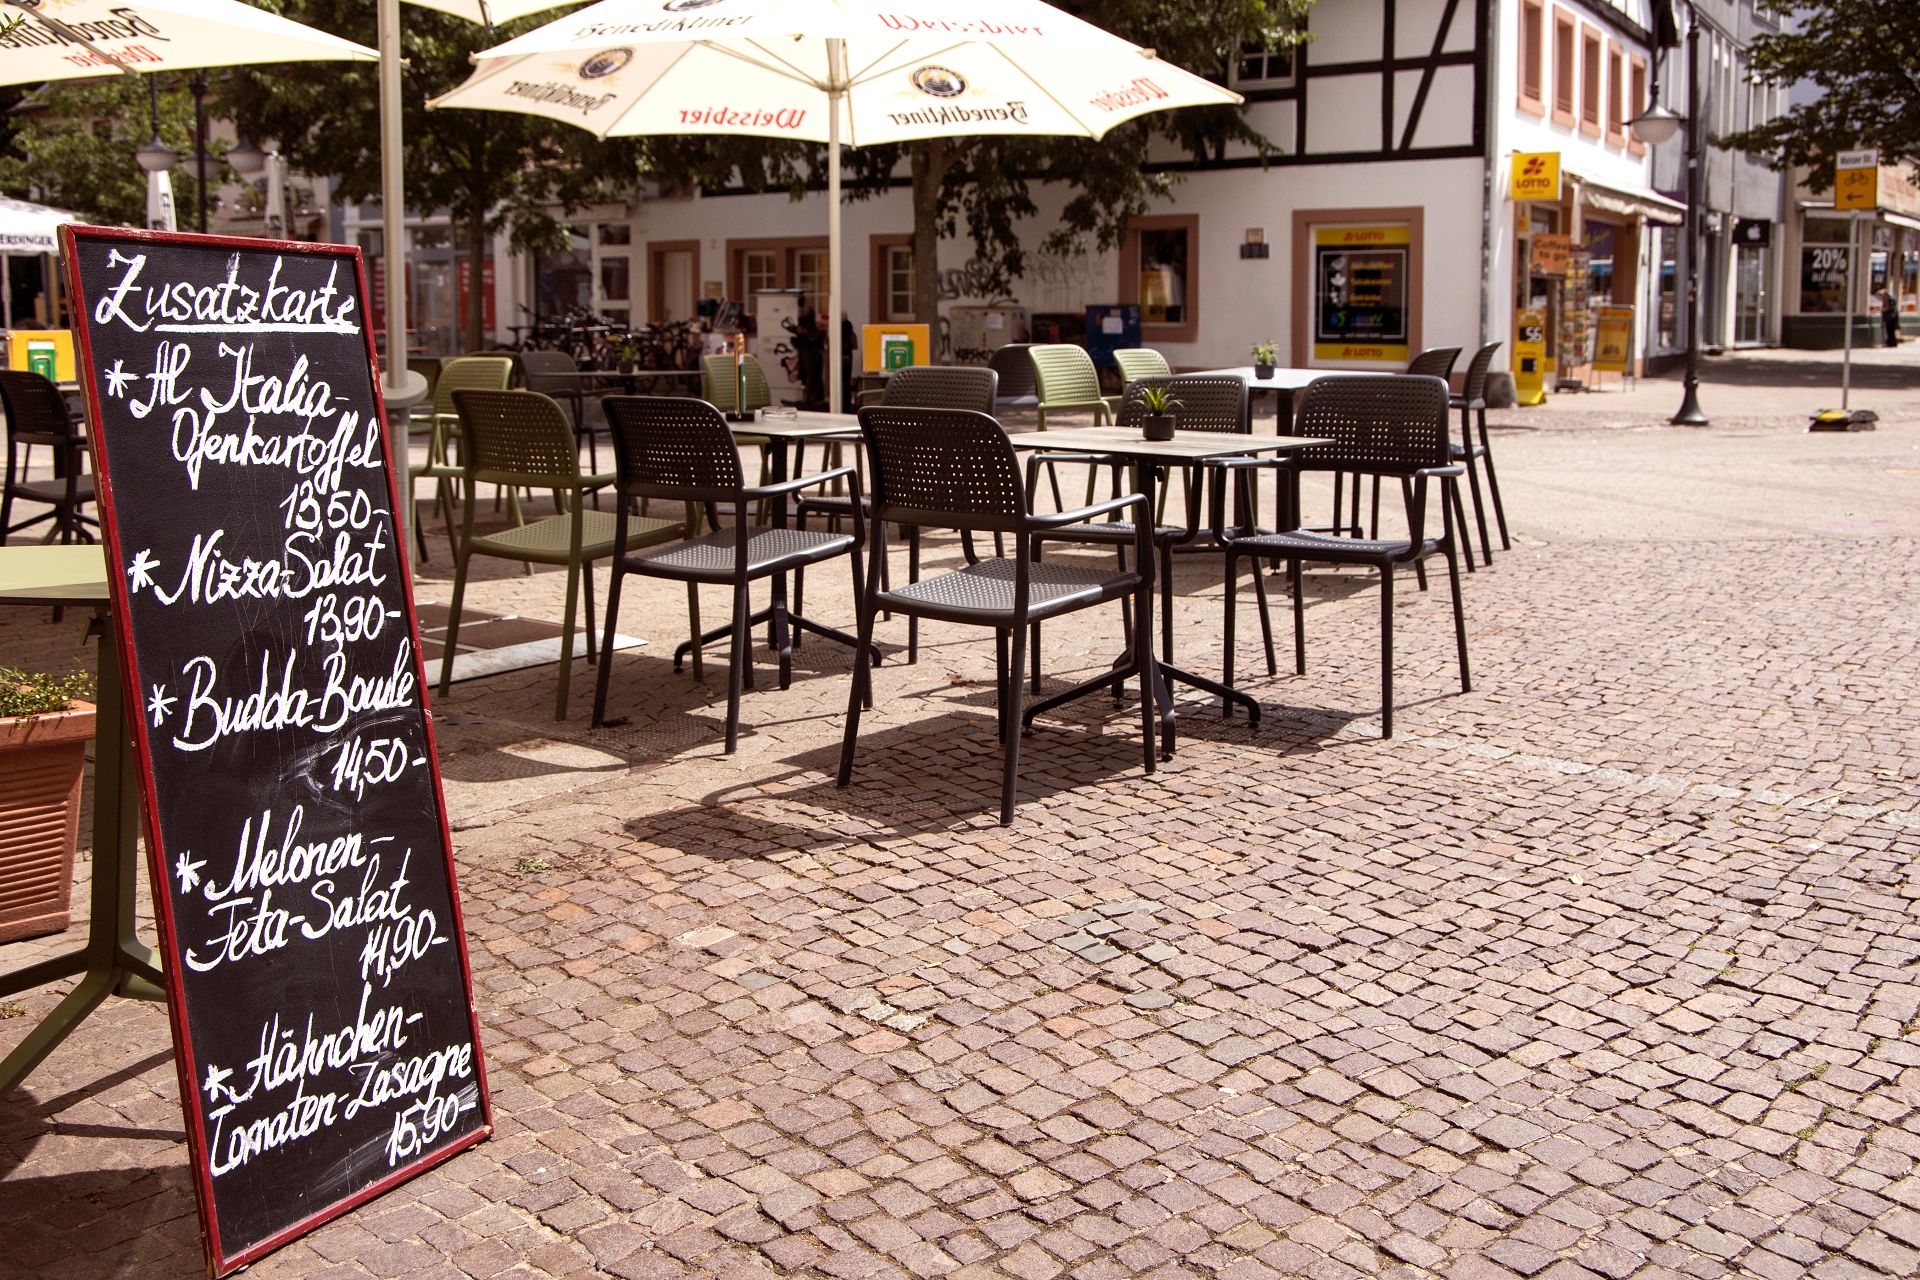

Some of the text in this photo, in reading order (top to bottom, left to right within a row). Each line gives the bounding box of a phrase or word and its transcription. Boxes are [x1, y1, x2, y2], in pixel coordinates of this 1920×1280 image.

[878, 12, 1044, 37] Weissbier
[1516, 178, 1550, 189] LOTTO
[1356, 231, 1386, 241] LOTTO
[1812, 249, 1847, 270] 20%
[1811, 271, 1826, 282] auf
[95, 248, 355, 332] Zusatzkarte
[1526, 326, 1543, 342] 56
[1354, 347, 1384, 358] LOTTO
[171, 407, 382, 495] Ofenkartoffel
[184, 847, 412, 972] Feta-Salat
